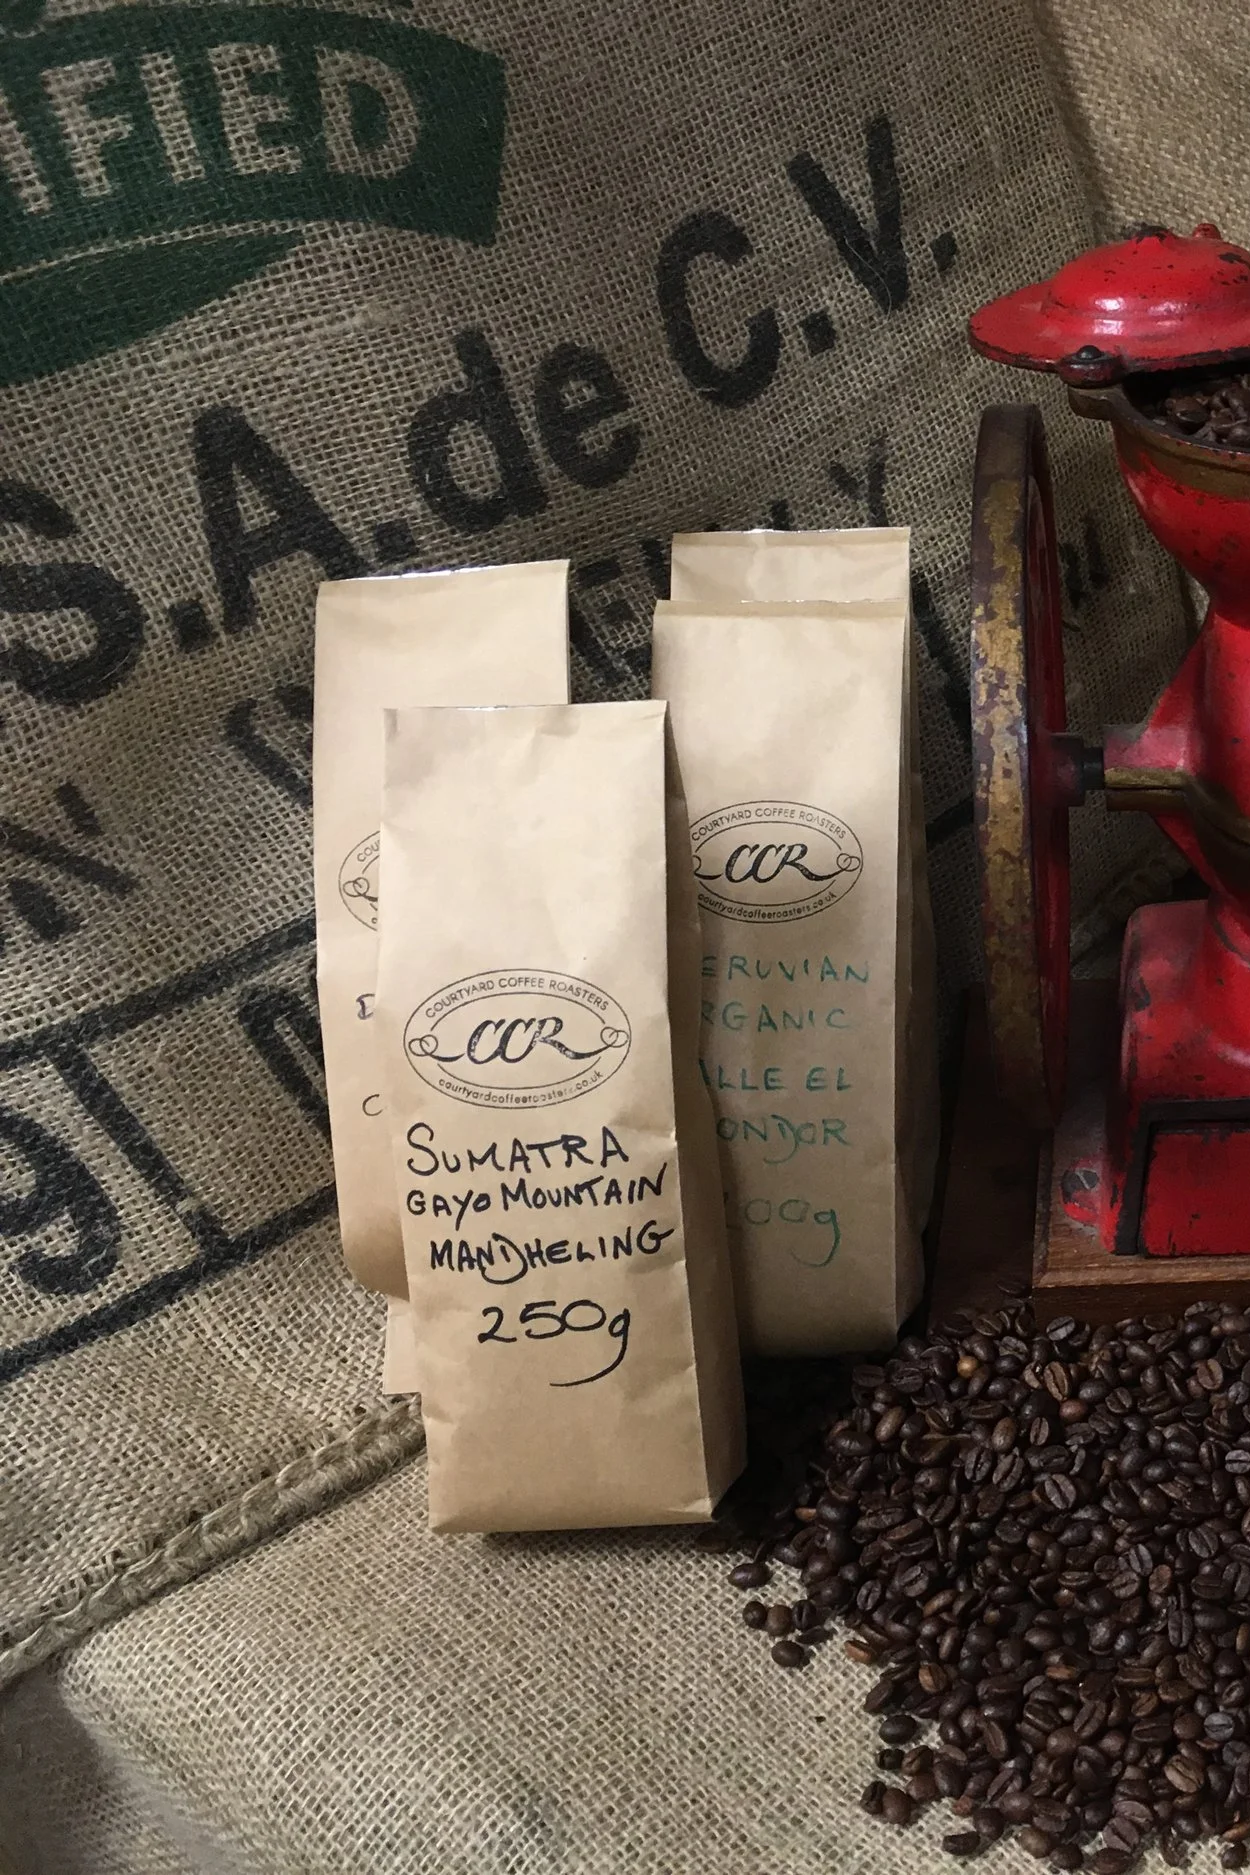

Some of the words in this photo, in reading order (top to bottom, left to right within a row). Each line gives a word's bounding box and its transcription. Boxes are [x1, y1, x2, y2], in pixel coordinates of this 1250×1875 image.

[691, 809, 752, 842] COURTYARD
[754, 807, 796, 820] COFFEE
[798, 810, 847, 840] ROASTERS
[724, 842, 843, 884] CCR
[425, 980, 495, 1018] COURTYARD
[497, 976, 545, 989] COFFEE
[548, 977, 610, 1013] ROASTERS
[466, 1015, 608, 1065] CCR
[805, 1066, 853, 1092] EL
[406, 1121, 630, 1177] SUMATRA
[500, 1161, 668, 1212] MOUNTAIN
[429, 1219, 676, 1286] MANDHELING
[476, 1298, 632, 1388] 250g
